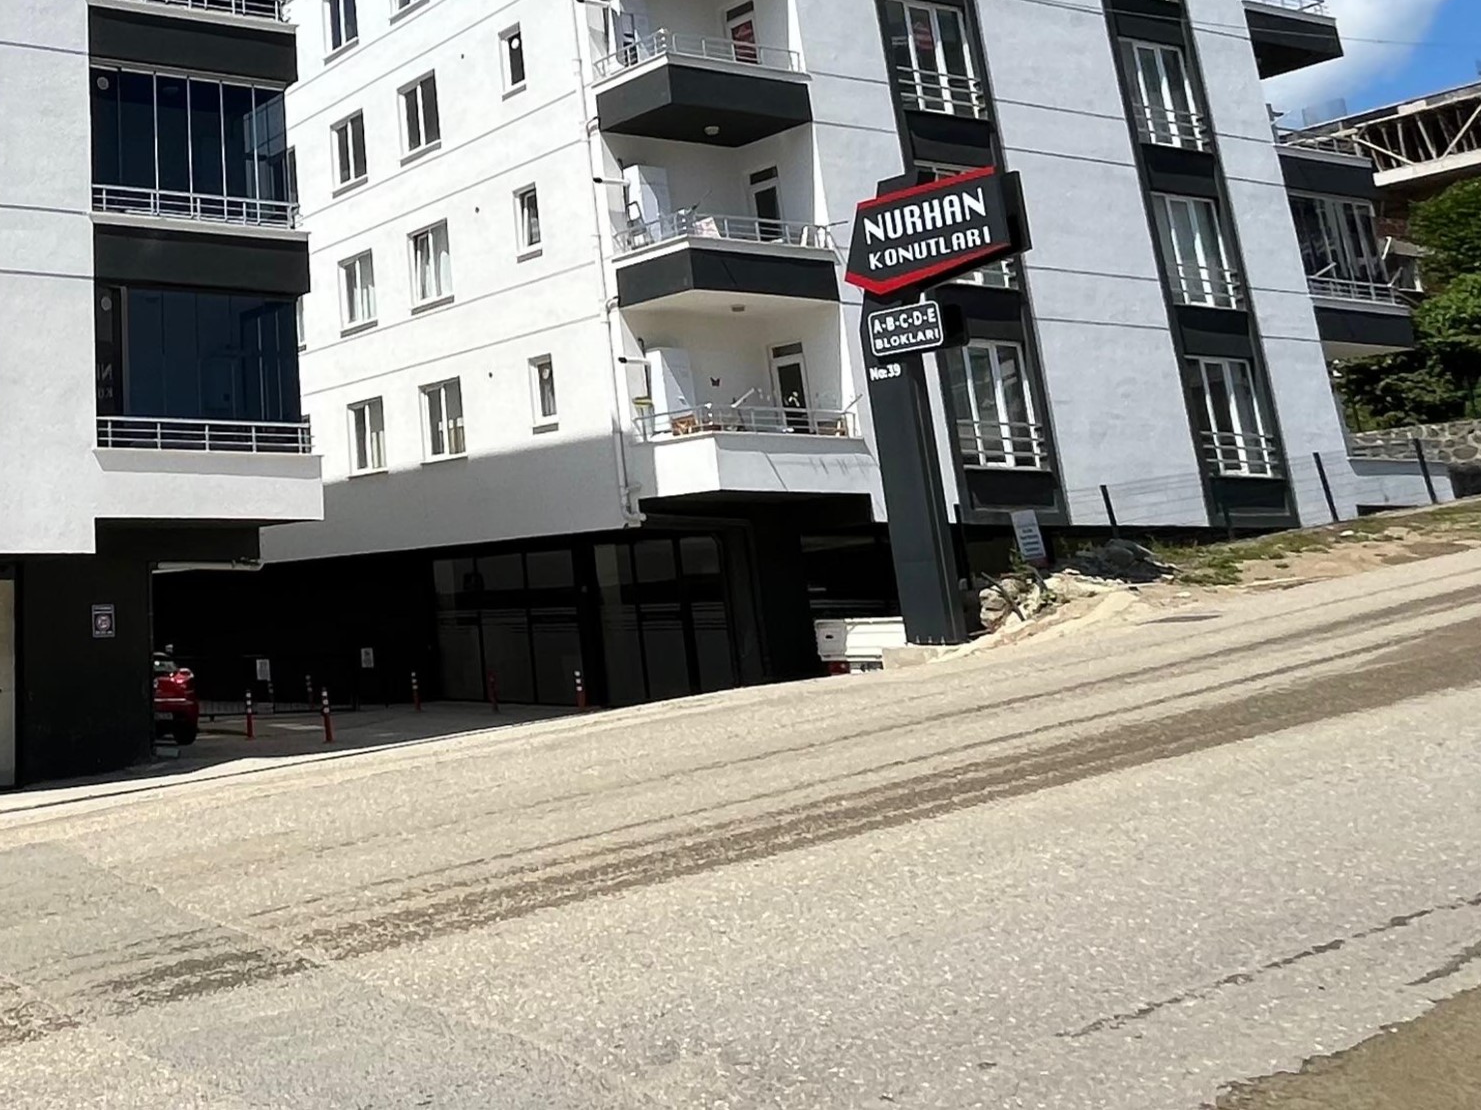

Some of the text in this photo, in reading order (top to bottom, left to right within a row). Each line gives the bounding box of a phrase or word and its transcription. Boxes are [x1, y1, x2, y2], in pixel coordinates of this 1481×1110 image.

[863, 187, 987, 245] NURHAN
[869, 225, 991, 270] KONUTLARI
[874, 328, 940, 350] BLOKLARI
[869, 363, 901, 381] No:39
